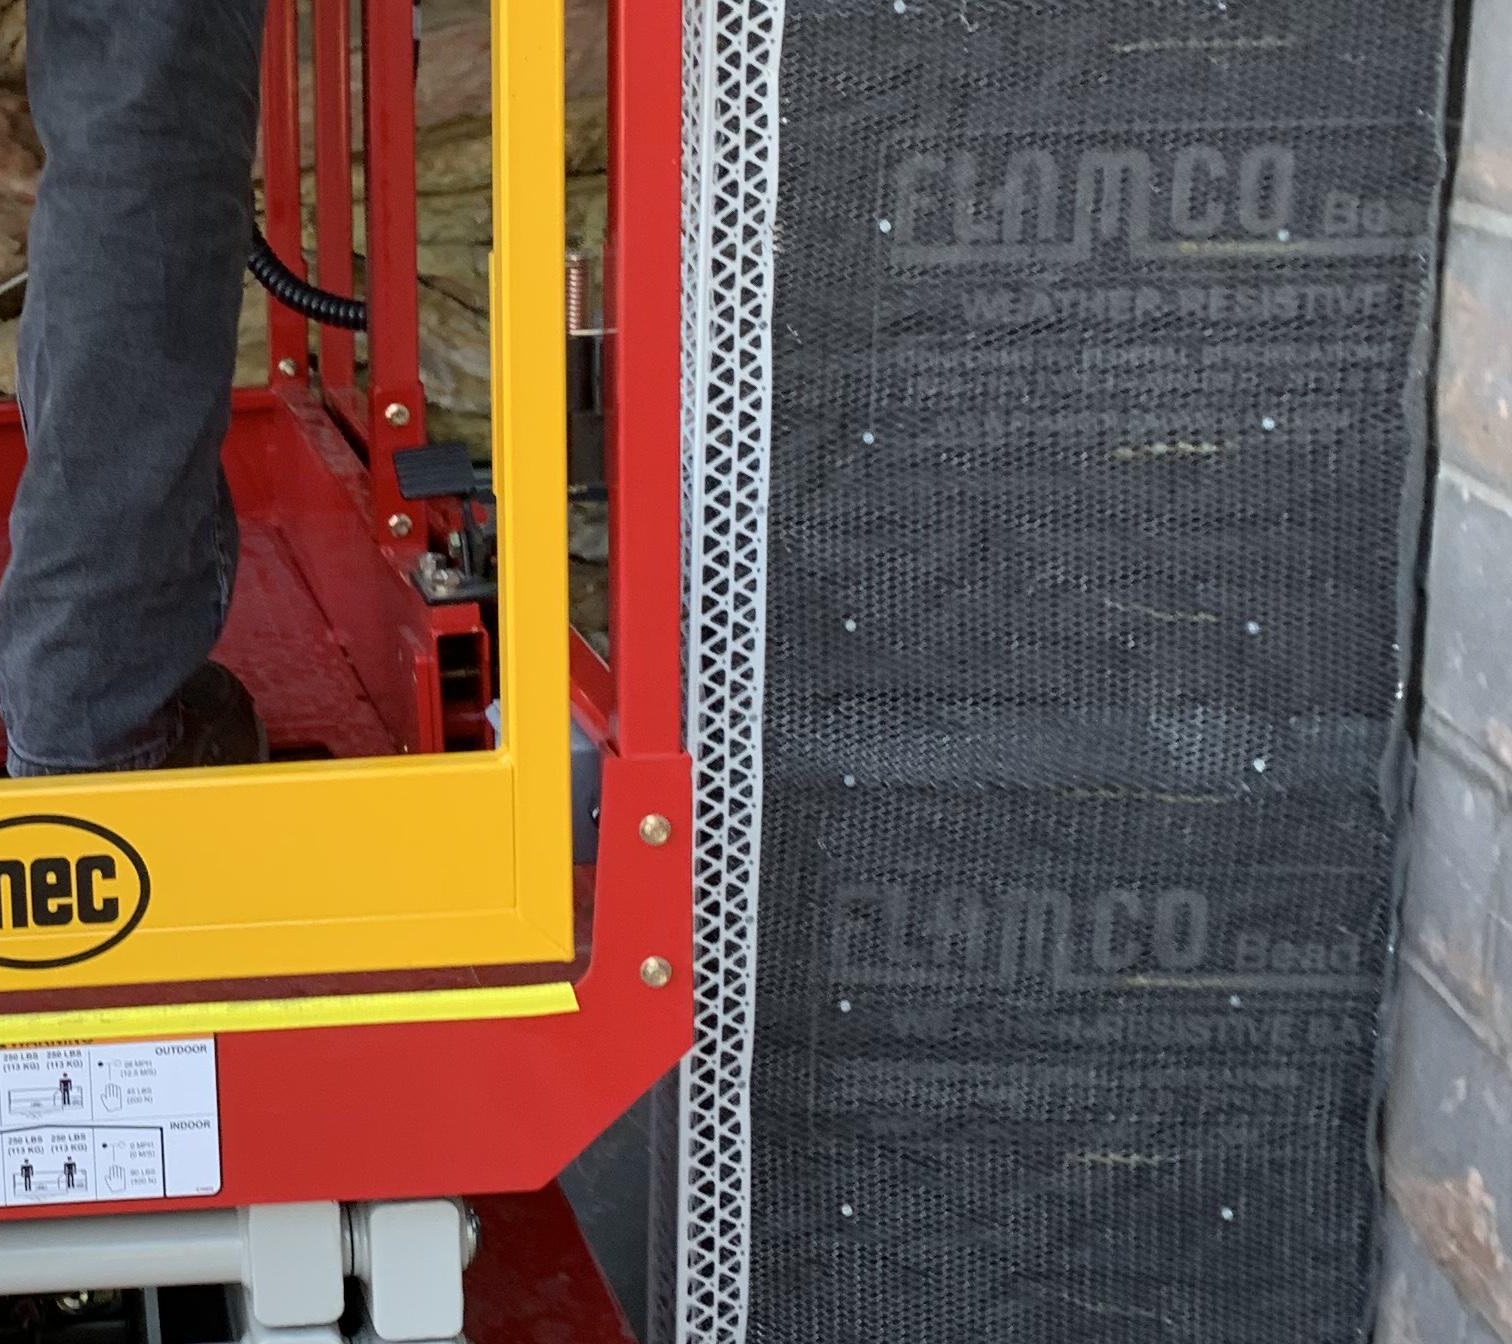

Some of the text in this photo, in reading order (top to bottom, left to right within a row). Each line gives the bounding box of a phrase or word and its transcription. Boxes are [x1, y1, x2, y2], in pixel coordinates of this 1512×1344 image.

[892, 144, 1296, 258] FLAMCO
[830, 885, 1210, 990] FLAMCO
[64, 1050, 82, 1058] LBS
[155, 1044, 207, 1056] OUTDOOR
[21, 1053, 38, 1061] LBS
[170, 1120, 211, 1130] INDOOR
[25, 1136, 43, 1144] LBS
[68, 1133, 86, 1142] LBS
